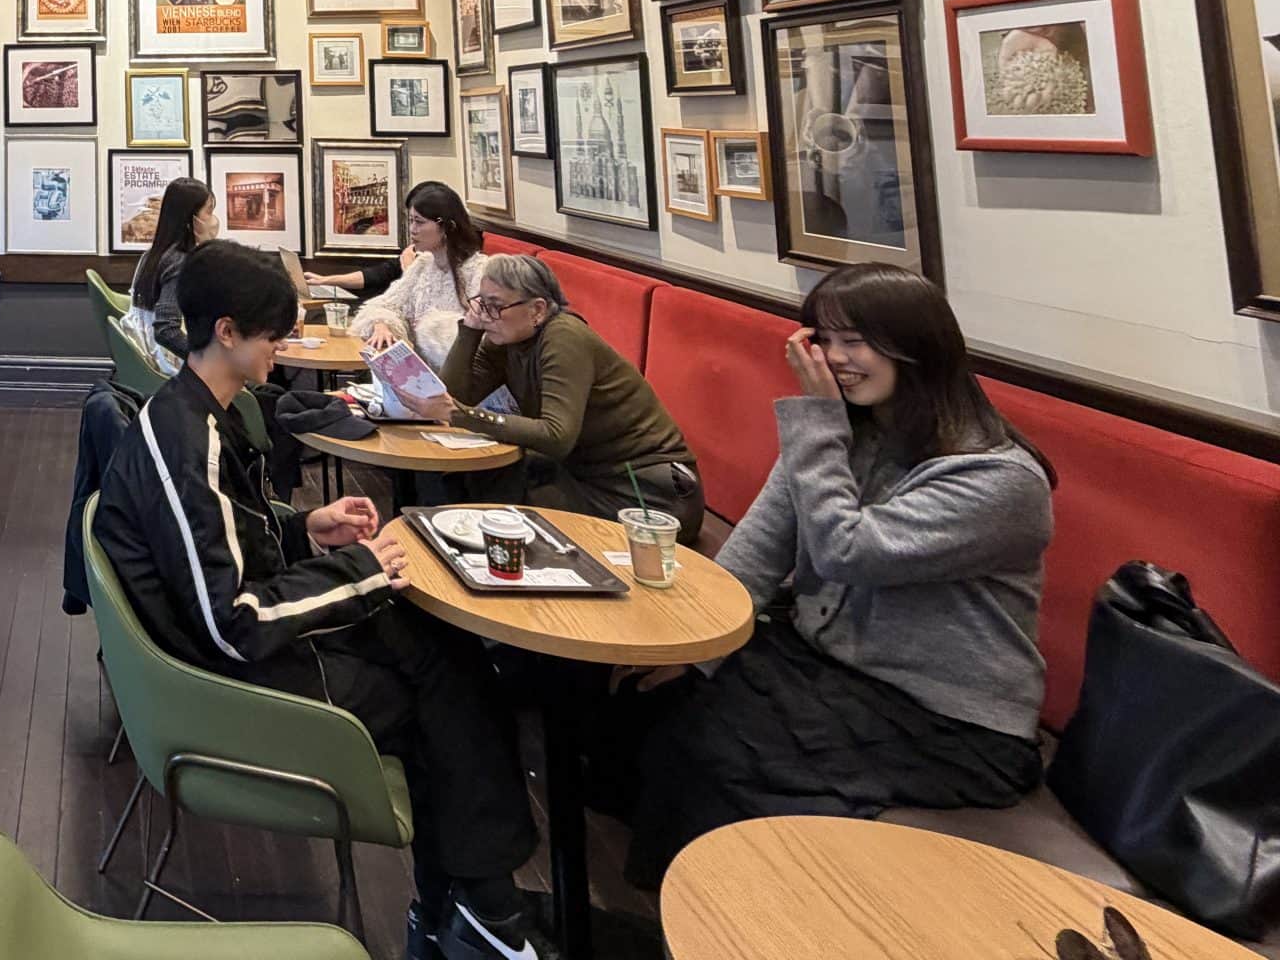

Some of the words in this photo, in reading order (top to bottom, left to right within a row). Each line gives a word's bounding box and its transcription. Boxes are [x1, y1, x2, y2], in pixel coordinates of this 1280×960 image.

[161, 7, 216, 18] VIENNESE
[217, 8, 242, 17] BLEND
[185, 16, 242, 26] STARBUCKS
[124, 171, 160, 180] ESTATE
[124, 179, 168, 188] PACAMAR
